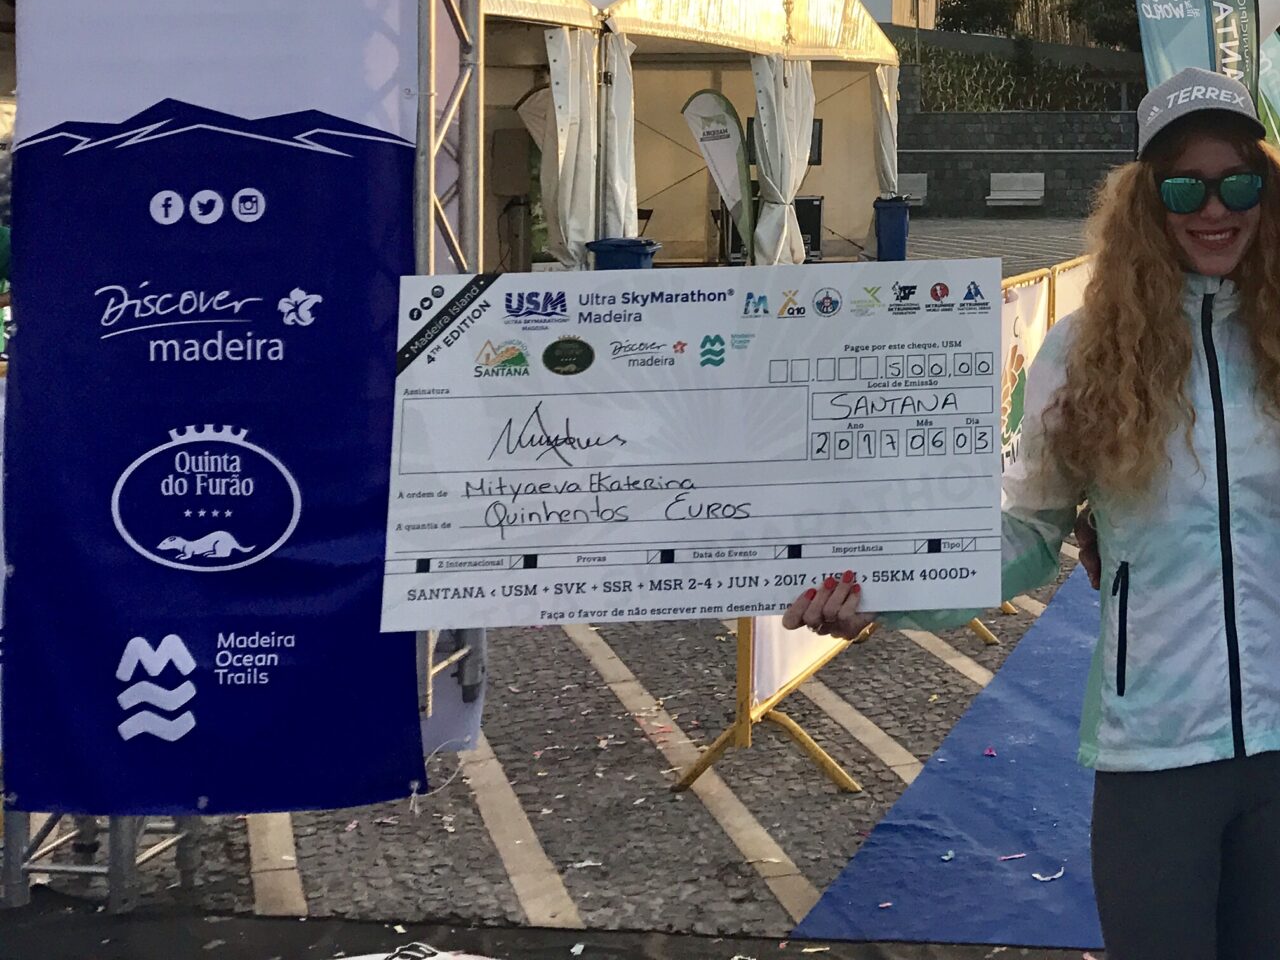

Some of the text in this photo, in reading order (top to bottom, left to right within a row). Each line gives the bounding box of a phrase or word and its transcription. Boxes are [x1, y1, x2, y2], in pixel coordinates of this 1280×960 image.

[1167, 86, 1246, 109] TERREX
[94, 281, 263, 327] Discover
[505, 292, 567, 314] USM
[579, 293, 616, 306] Ultra
[410, 285, 479, 353] Madeira Island
[443, 300, 491, 347] EDITION
[578, 310, 642, 323] Madeira
[149, 331, 284, 362] madeira
[610, 340, 667, 355] Discover
[844, 340, 962, 352] Pague USM
[628, 356, 675, 367] madeira
[474, 366, 530, 378] SANTANA
[868, 378, 938, 388] Local Emissão
[403, 388, 449, 396] Assinatura
[830, 392, 959, 419] SANTANA
[847, 417, 980, 430] Ano Dia
[174, 451, 241, 475] Quinta
[161, 474, 254, 496] do Furão
[464, 477, 581, 504] Mityaeva
[406, 490, 434, 499] ordem
[484, 496, 629, 540] Quinhentos
[404, 521, 438, 532] quantia
[727, 549, 757, 558] Evento
[832, 544, 884, 554] Importância
[446, 558, 504, 569] Internacional
[576, 554, 606, 563] Provas
[407, 568, 978, 602] SANTANA USM SVK SSR MSR 2-4 JUN 2017 55KM 4000D+
[540, 609, 565, 621] Faça
[577, 607, 608, 618] favor
[627, 604, 647, 616] não
[650, 605, 697, 616] escrever
[700, 603, 723, 614] nem
[726, 602, 776, 613] desenhar
[216, 631, 295, 649] Madeira
[215, 650, 278, 667] Ocean
[214, 669, 269, 685] Trails
